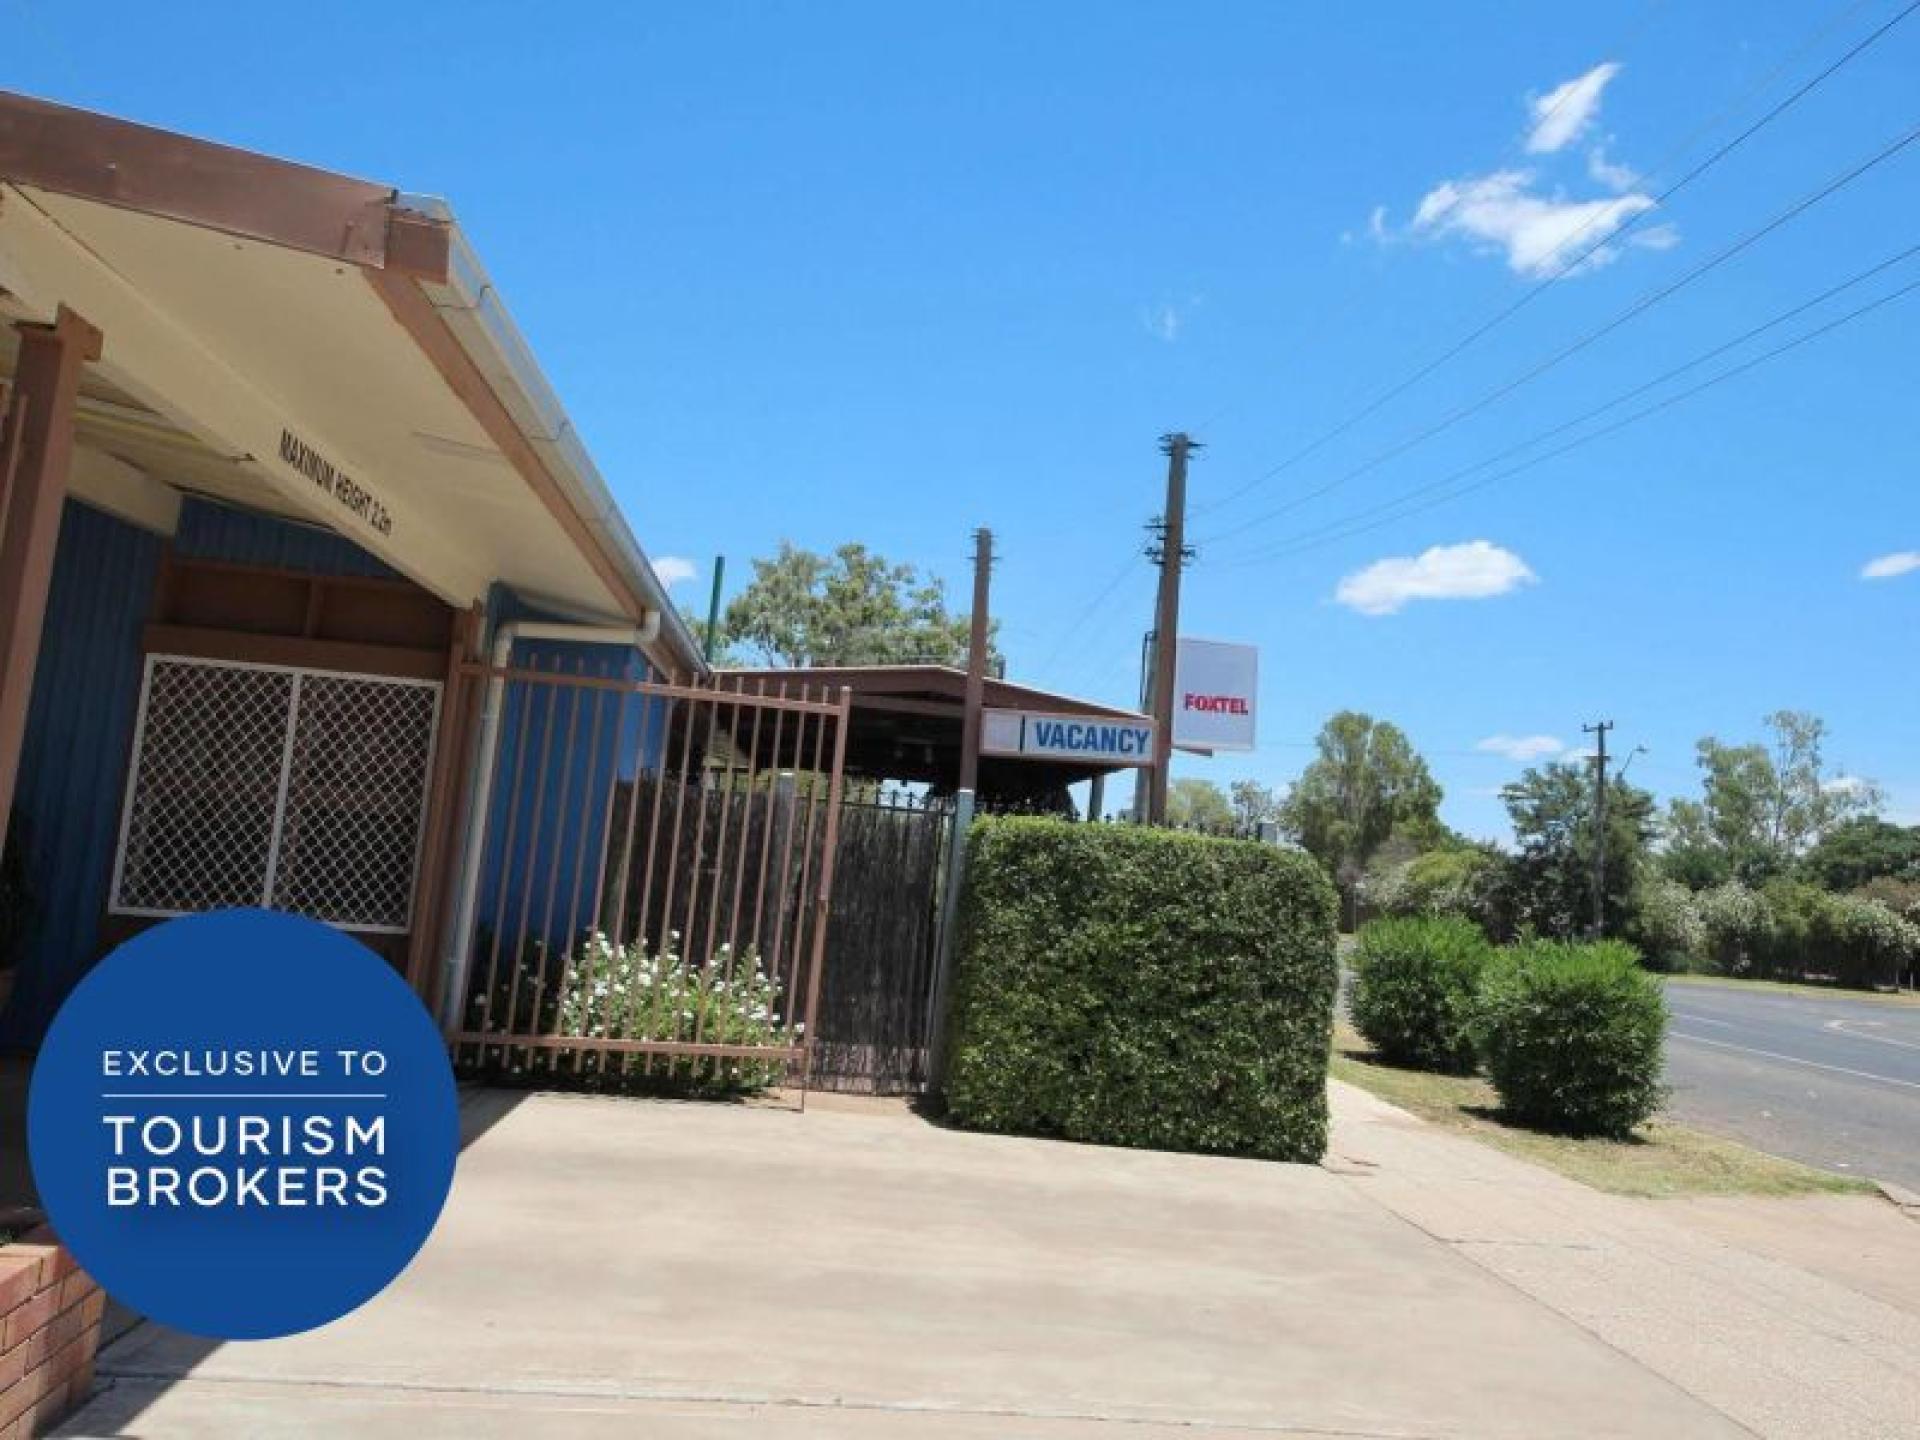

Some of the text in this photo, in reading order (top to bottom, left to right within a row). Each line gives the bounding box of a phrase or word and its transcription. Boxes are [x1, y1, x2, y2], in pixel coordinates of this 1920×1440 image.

[279, 428, 334, 496] MAXIMUM
[335, 472, 372, 520] HEIGHT
[1184, 692, 1249, 716] FOXTEL
[1035, 721, 1150, 754] VACANCY
